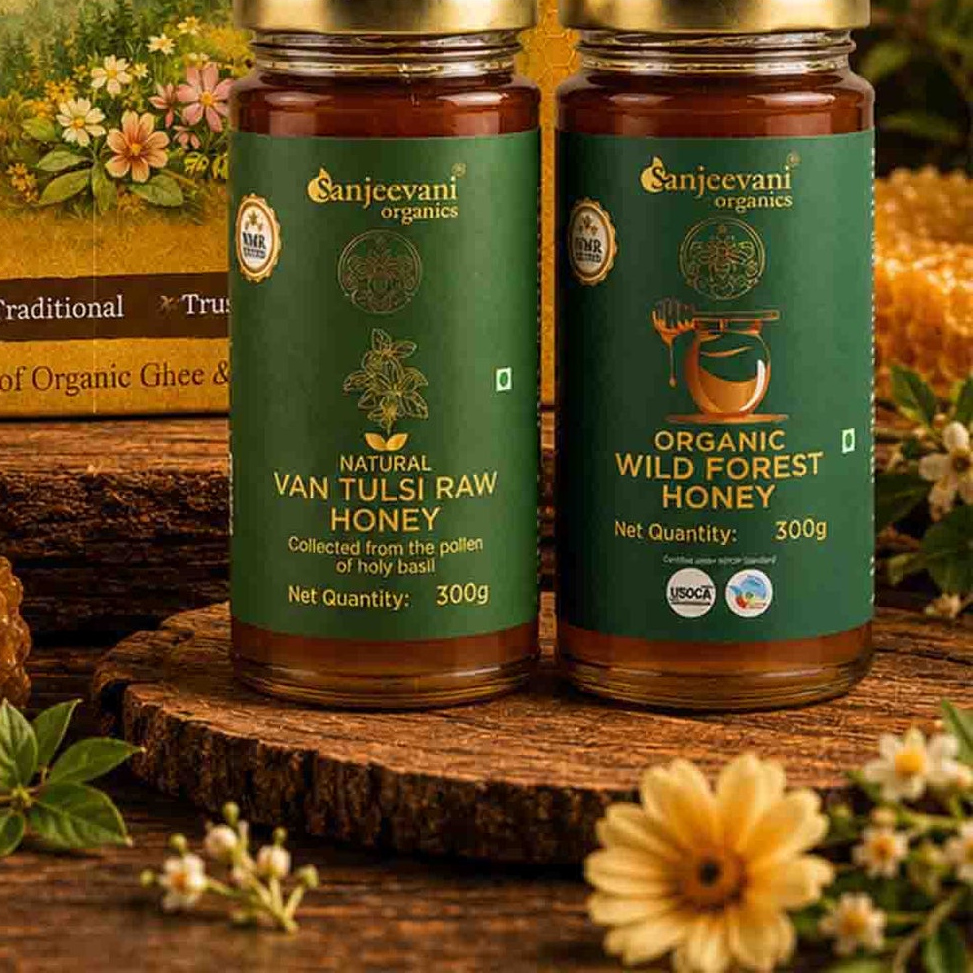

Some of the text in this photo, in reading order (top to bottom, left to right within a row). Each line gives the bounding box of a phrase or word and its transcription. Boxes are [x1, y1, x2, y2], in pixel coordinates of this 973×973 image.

[307, 171, 458, 209] Sanjeevani
[639, 158, 792, 199] Sanjeevani
[381, 202, 459, 225] organics
[715, 191, 793, 214] organics
[31, 363, 131, 396] Organic
[140, 361, 205, 388] Ghee
[213, 360, 231, 385] &
[654, 430, 786, 451] ORGANIC
[339, 455, 432, 473] NATURAL
[615, 452, 824, 480] WILD FOREST
[273, 472, 498, 502] VAN TULSI RAW
[662, 484, 776, 510] HONEY
[330, 507, 442, 532] HONEY
[614, 519, 827, 546] Net Quantity: 300g
[288, 536, 483, 558] Collected from the pollen
[336, 558, 436, 578] of holy basil
[288, 582, 490, 611] Net Quantity: 300g
[670, 586, 712, 600] USOCA
